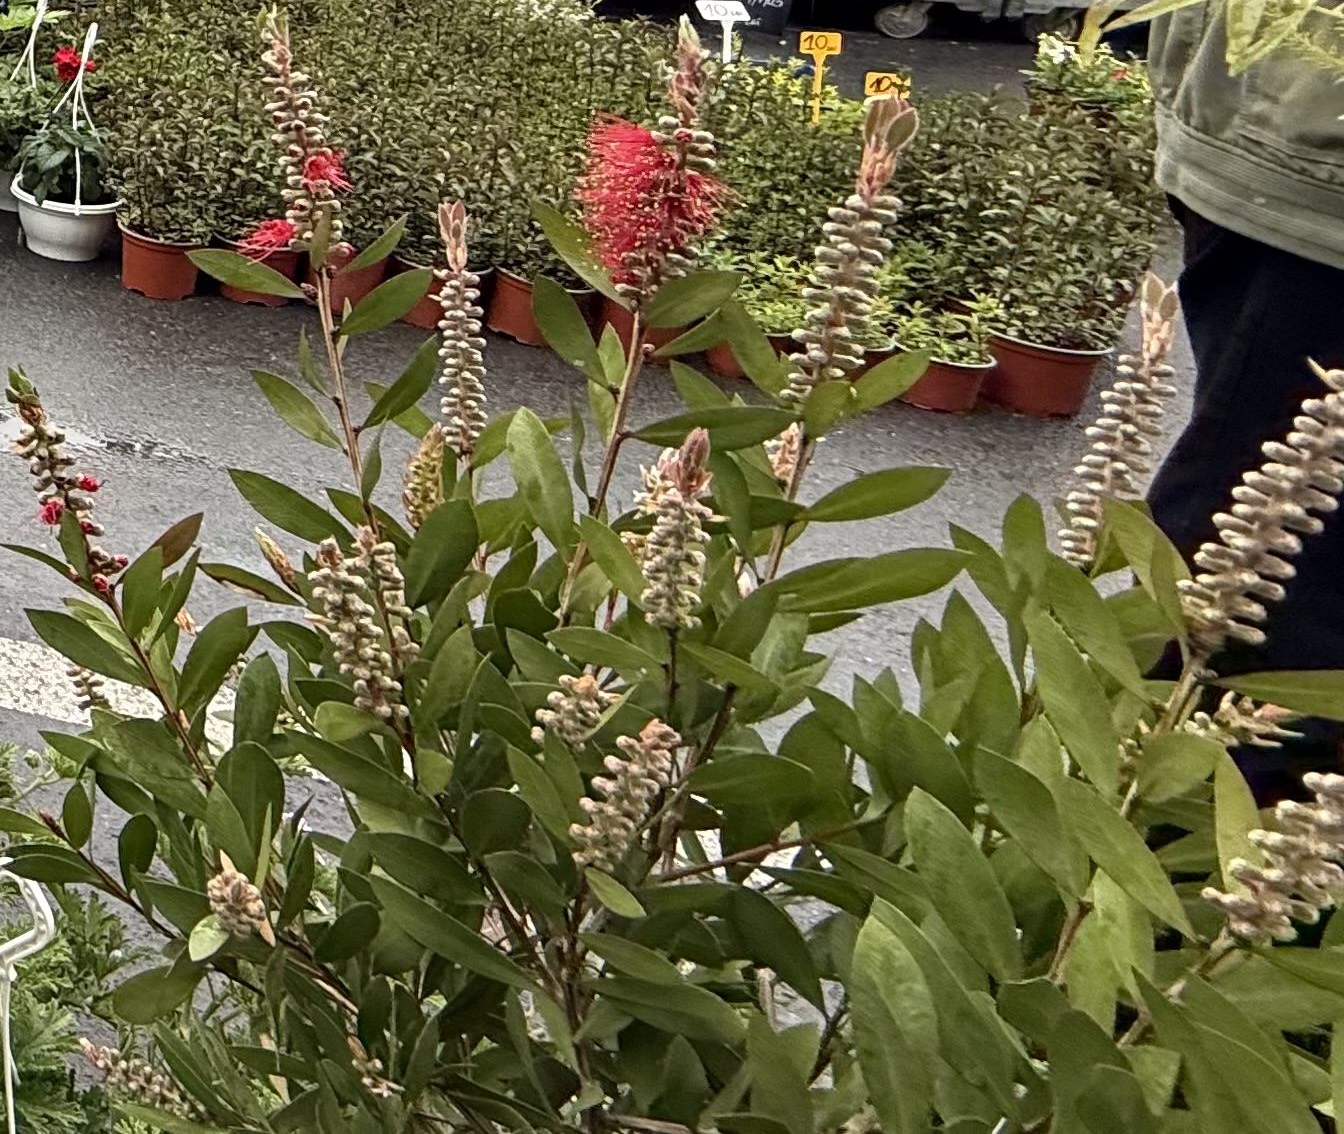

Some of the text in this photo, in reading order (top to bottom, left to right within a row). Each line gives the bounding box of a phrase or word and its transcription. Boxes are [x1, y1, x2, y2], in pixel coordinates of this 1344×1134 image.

[703, 3, 729, 17] 10
[803, 34, 828, 50] 10
[869, 75, 892, 93] 10
